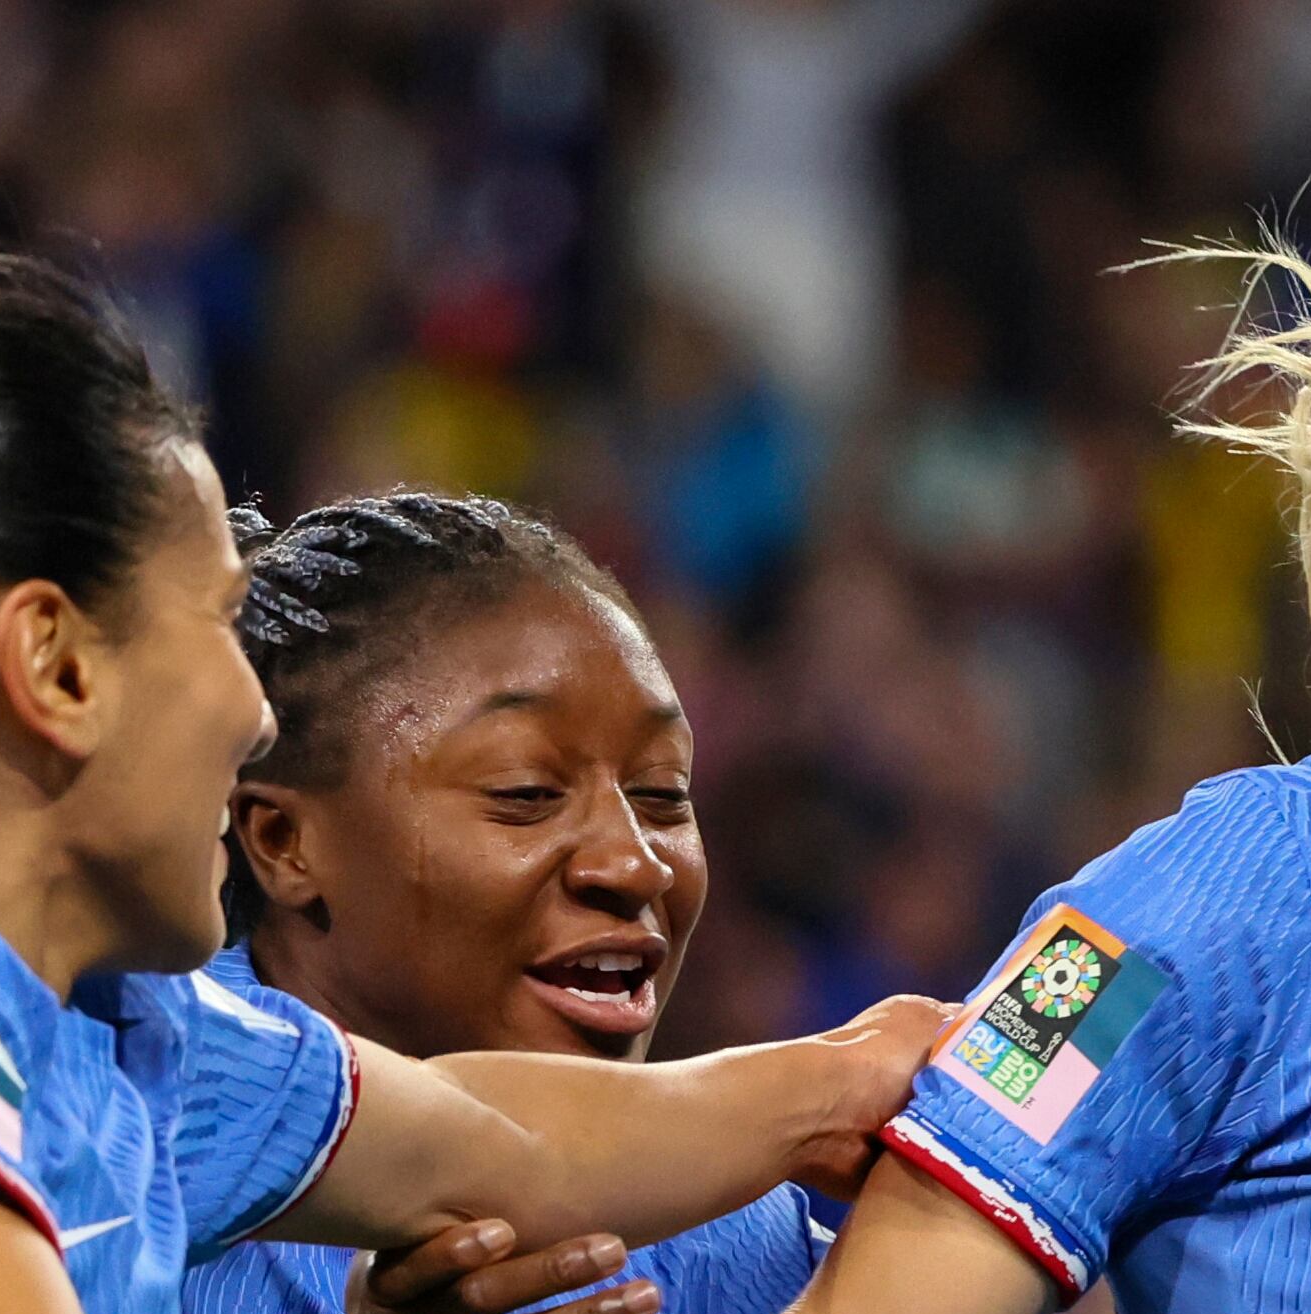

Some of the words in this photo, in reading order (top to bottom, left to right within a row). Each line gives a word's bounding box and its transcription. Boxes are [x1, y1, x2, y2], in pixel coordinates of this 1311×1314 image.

[998, 992, 1023, 1016] FIFA
[984, 1010, 1021, 1040] WORLD
[1019, 1035, 1042, 1052] CUP
[991, 1002, 1039, 1040] WOMEN'S
[956, 1039, 994, 1072] NZ
[967, 1026, 1006, 1056] AU
